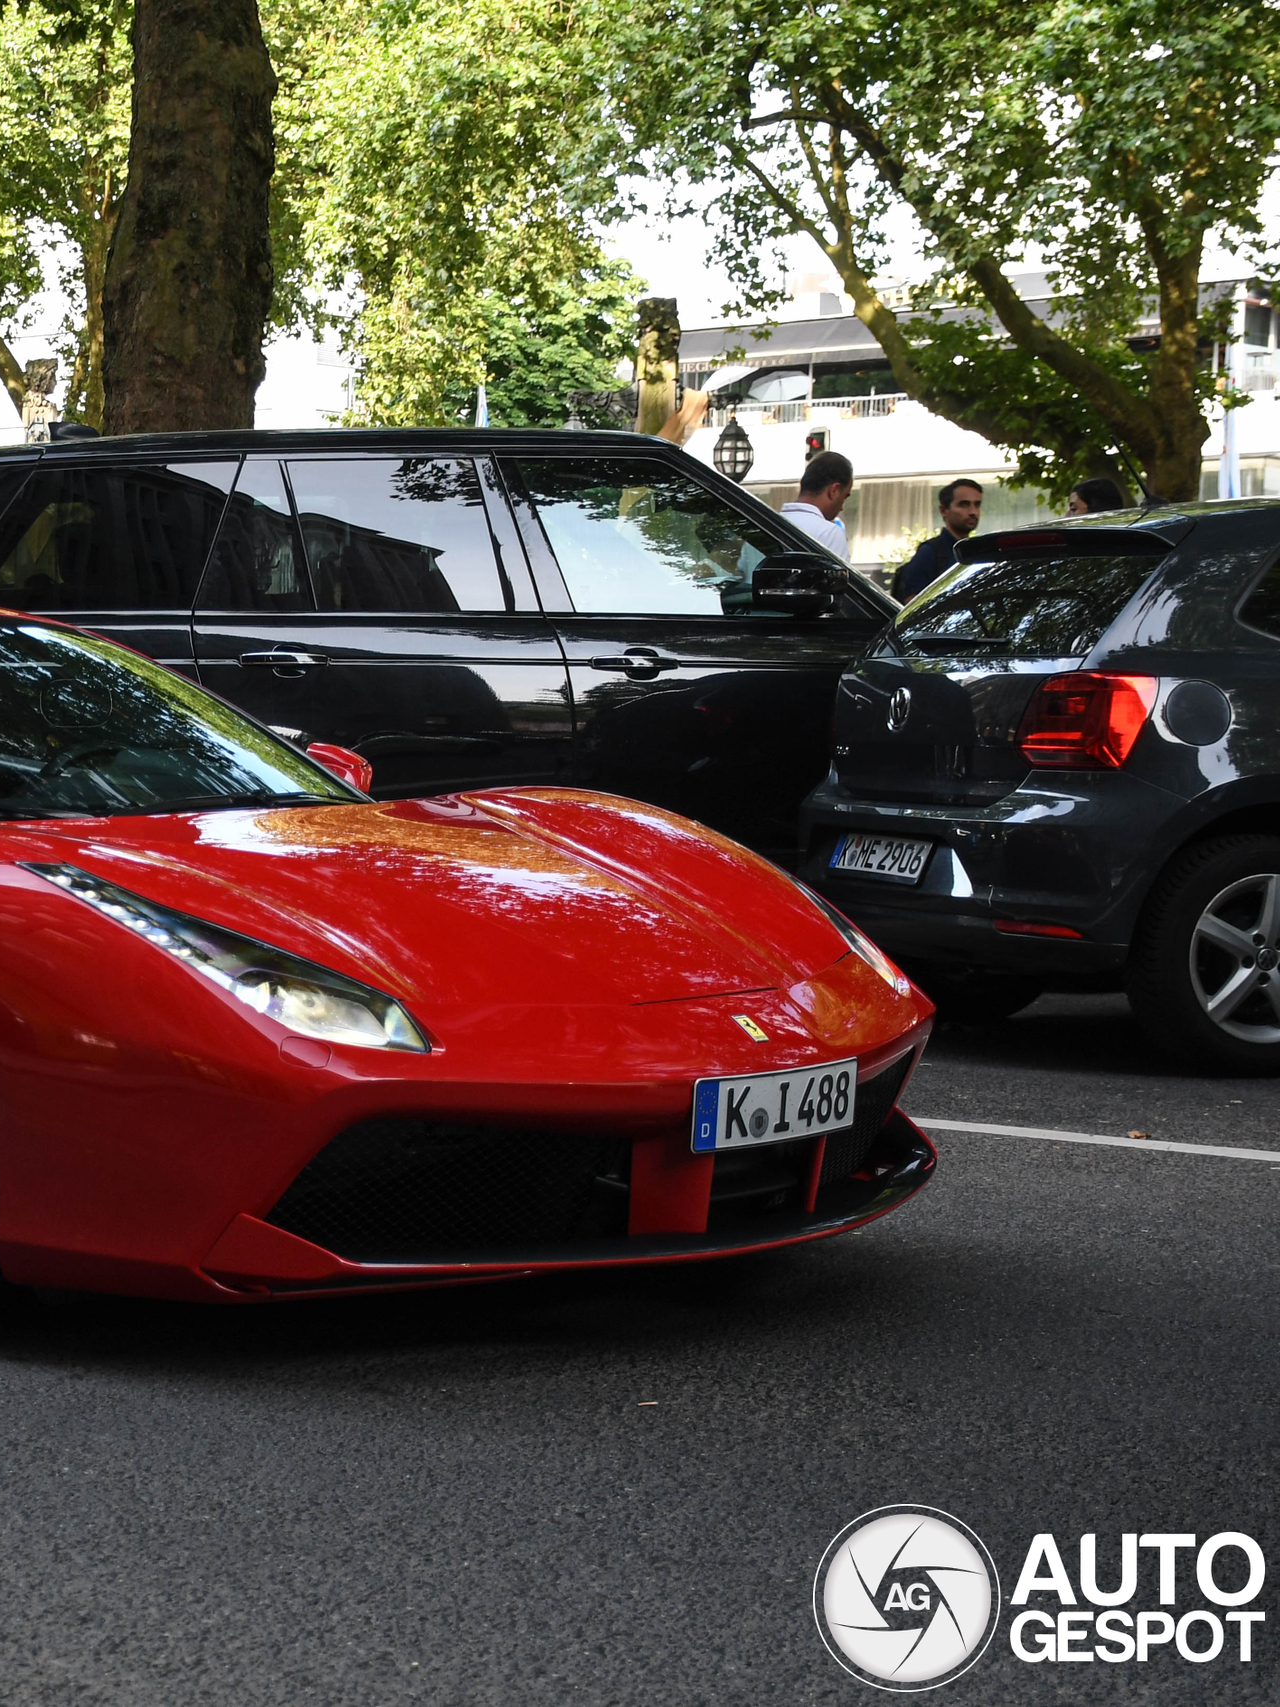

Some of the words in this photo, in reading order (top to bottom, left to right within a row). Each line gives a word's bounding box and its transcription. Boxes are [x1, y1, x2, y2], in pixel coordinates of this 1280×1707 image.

[837, 838, 856, 867] K
[854, 838, 881, 869] ME
[876, 841, 928, 875] 2906
[725, 1086, 751, 1139] K
[797, 1070, 850, 1127] 488
[700, 1122, 711, 1138] D
